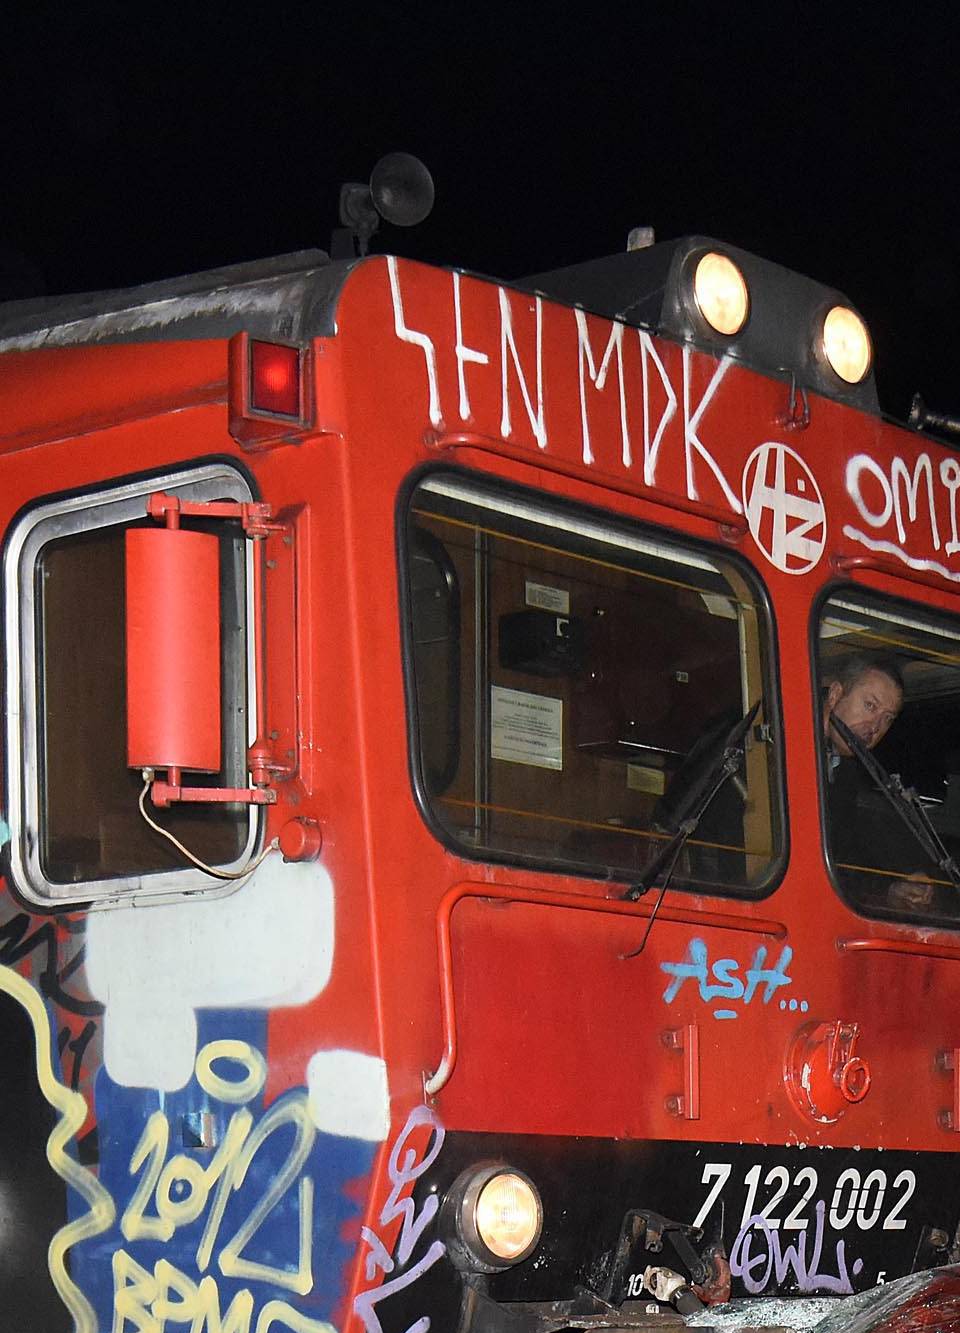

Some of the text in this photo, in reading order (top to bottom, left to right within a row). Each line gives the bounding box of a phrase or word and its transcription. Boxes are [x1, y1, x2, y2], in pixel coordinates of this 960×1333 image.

[574, 304, 743, 514] MDK
[693, 1163, 917, 1231] 7 122 002
[627, 1273, 644, 1297] 10
